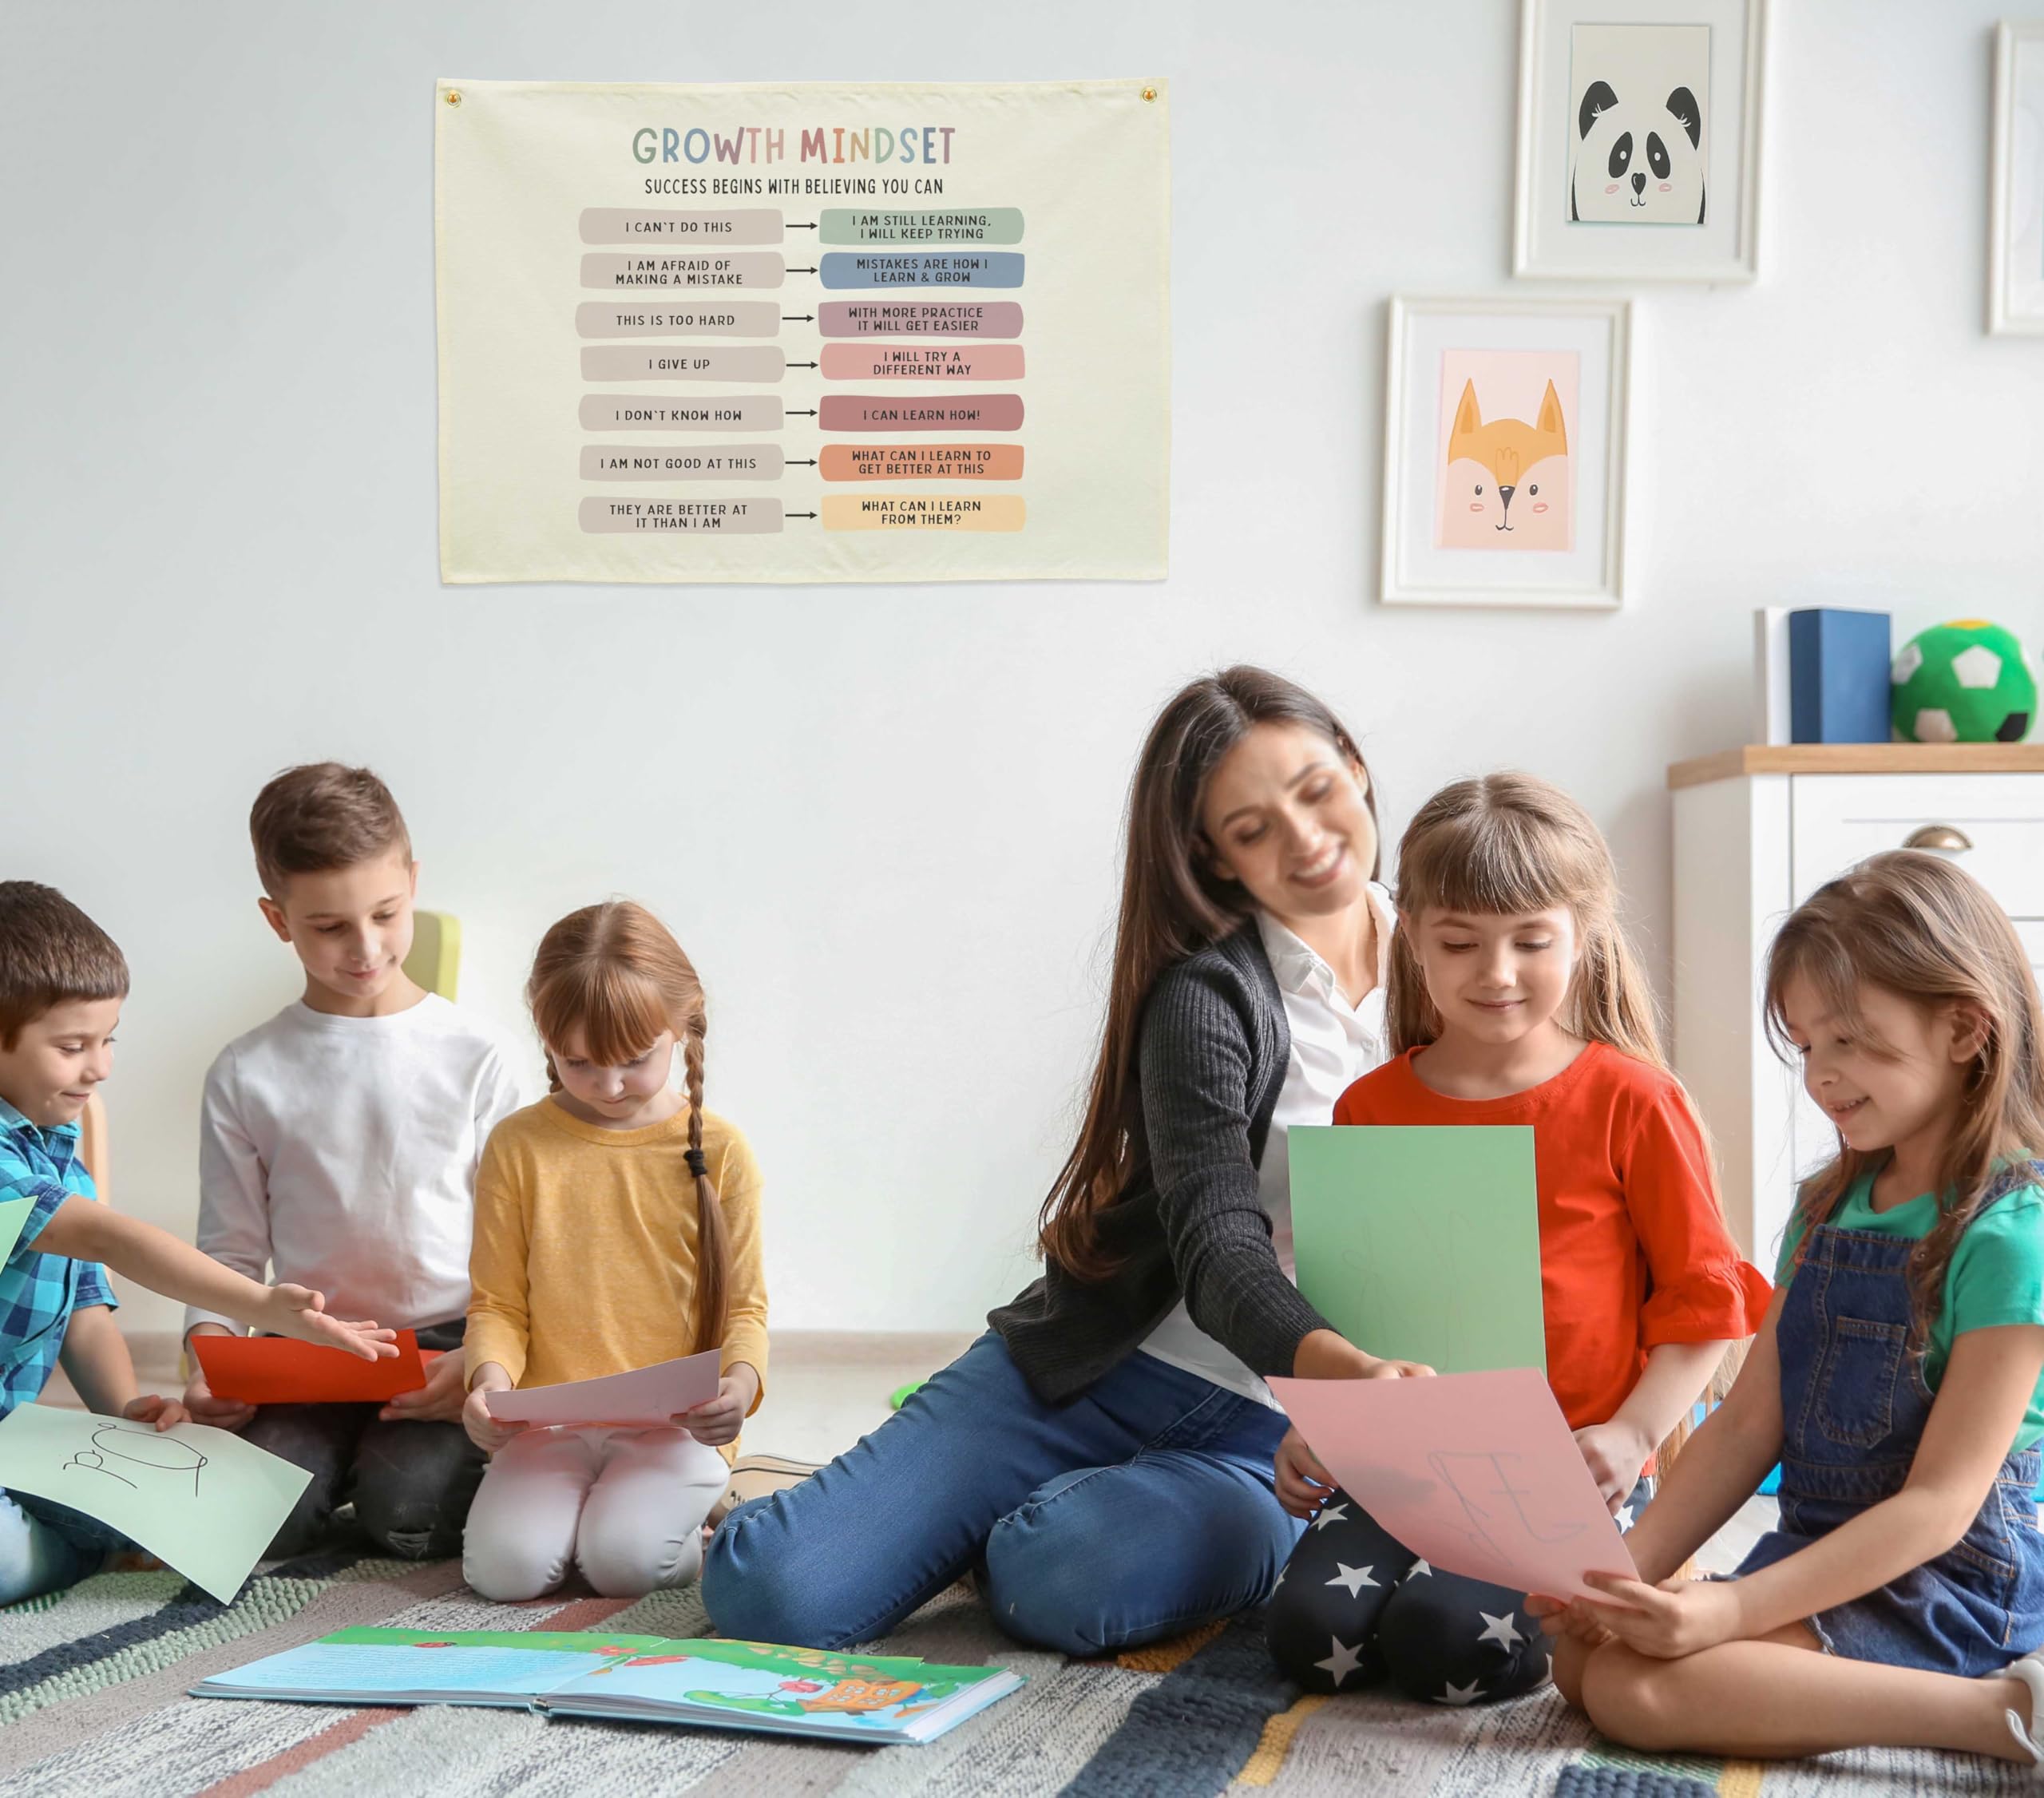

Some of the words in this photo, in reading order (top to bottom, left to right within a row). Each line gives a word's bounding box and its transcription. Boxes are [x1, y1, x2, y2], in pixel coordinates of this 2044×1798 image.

[632, 126, 785, 164] GROWTH
[800, 127, 956, 164] MINDSET
[644, 178, 707, 195] SUCCESS
[713, 178, 763, 195] BEGINS
[768, 178, 799, 195] WITH
[805, 178, 876, 195] BELIEVING
[881, 178, 909, 194] YOU
[914, 178, 943, 195] CAN
[680, 221, 698, 232] DO
[703, 222, 732, 233] THIS
[861, 215, 878, 226] AM
[884, 215, 917, 226] STILL
[921, 215, 991, 227] LEARNING,
[869, 228, 896, 240] WILL
[901, 228, 933, 240] KEEP
[937, 228, 984, 240] TRYING
[636, 260, 656, 271] AM
[660, 260, 710, 271] AFRAID
[715, 260, 731, 271] OF
[857, 258, 918, 270] MISTAKES
[923, 258, 949, 270] ARE
[953, 258, 980, 269] HOW
[616, 274, 667, 285] MAKING
[673, 274, 682, 285] A
[687, 274, 743, 285] MISTAKE
[873, 271, 916, 283] LEARN
[921, 271, 929, 283] &
[935, 271, 971, 283] GROW
[849, 307, 877, 319] WITH
[882, 307, 917, 318] MORE
[921, 307, 984, 319] PRACTICE
[616, 315, 645, 326] THIS
[651, 315, 663, 326] IS
[668, 315, 694, 327] TOO
[699, 315, 735, 326] HARD
[858, 320, 869, 331] IT
[873, 320, 901, 331] WILL
[905, 320, 929, 331] GET
[933, 320, 979, 331] EASIER
[892, 350, 920, 362] WILL
[924, 351, 948, 362] TRY
[953, 351, 961, 362] A
[658, 358, 687, 370] GIVE
[693, 358, 711, 370] UP
[873, 364, 941, 375] DIFFERENT
[946, 364, 972, 375] WAY
[671, 410, 709, 421] KNOW
[715, 410, 742, 421] HOW
[871, 410, 898, 421] CAN
[903, 410, 945, 421] LEARN
[949, 410, 980, 421] HOW!
[852, 450, 885, 461] WHAT
[889, 450, 917, 461] CAN
[929, 450, 972, 461] LEARN
[976, 450, 991, 461] TO
[609, 458, 628, 469] AM
[633, 458, 660, 469] NOT
[665, 457, 702, 469] GOOD
[707, 458, 723, 469] AT
[727, 458, 756, 469] THIS
[858, 463, 881, 474] GET
[886, 463, 933, 474] BETTER
[937, 463, 953, 474] AT
[957, 463, 984, 474] THIS
[609, 504, 642, 516] THEY
[647, 504, 673, 515] ARE
[679, 504, 727, 515] BETTER
[732, 505, 748, 515] AT
[862, 501, 895, 512] WHAT
[900, 501, 926, 512] CAN
[939, 501, 981, 512] LEARN
[636, 517, 648, 529] IT
[652, 517, 687, 529] THAN
[702, 517, 721, 529] AM
[881, 513, 916, 525] FROM
[921, 513, 961, 525] THEM?
